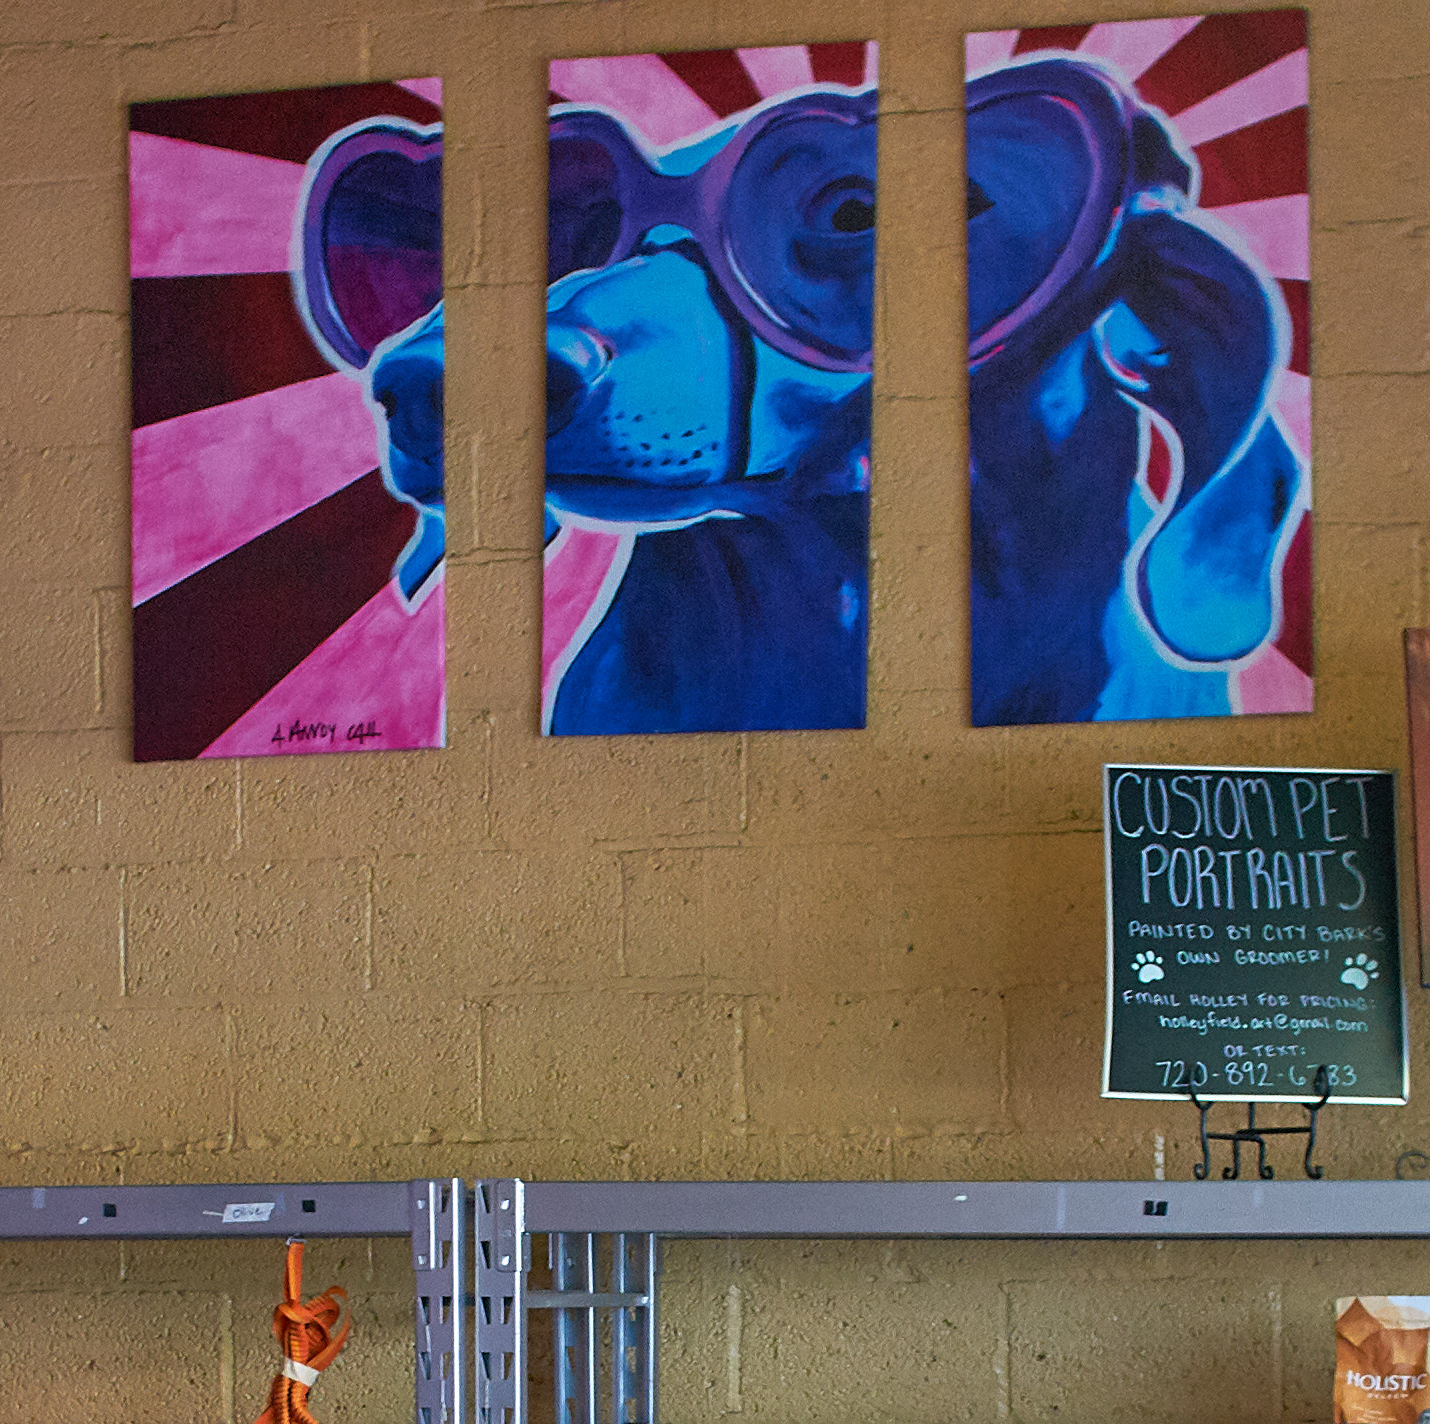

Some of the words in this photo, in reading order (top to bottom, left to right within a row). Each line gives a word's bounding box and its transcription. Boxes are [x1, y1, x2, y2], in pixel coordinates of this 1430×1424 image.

[1113, 771, 1277, 840] CUSTOM
[1289, 776, 1374, 841] PET
[1141, 843, 1366, 910] PORTRAITS
[1128, 920, 1214, 940] PAINTED
[1226, 924, 1251, 940] BY
[1263, 925, 1308, 941] CITY
[1176, 950, 1220, 965] OWN
[1235, 949, 1330, 964] GROOMER!
[1122, 989, 1180, 1007] EMAIL
[1257, 993, 1290, 1006] FOR
[1223, 1045, 1247, 1057] OR
[1346, 1369, 1428, 1392] HOLISTIC
